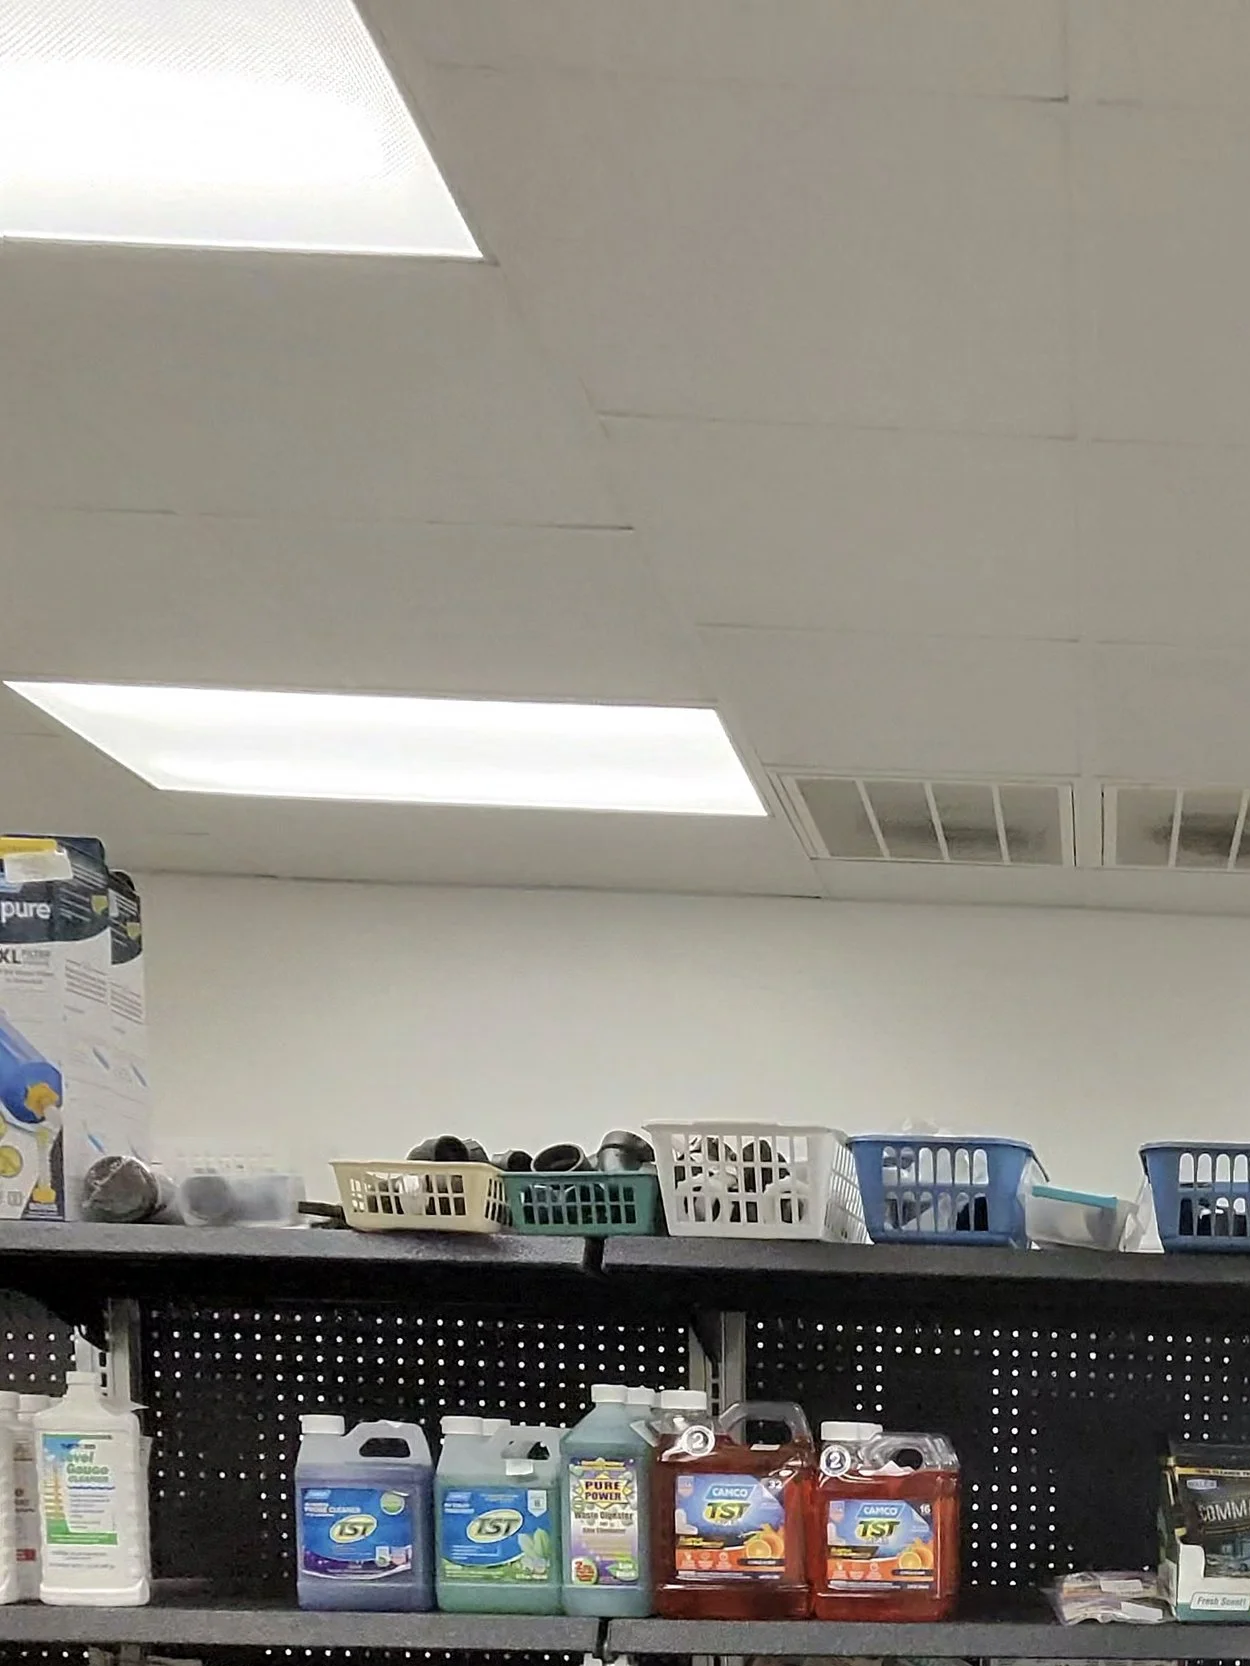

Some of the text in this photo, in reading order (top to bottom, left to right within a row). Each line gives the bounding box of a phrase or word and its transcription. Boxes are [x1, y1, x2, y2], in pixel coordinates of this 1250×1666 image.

[1, 901, 51, 923] pure
[585, 1481, 621, 1490] PURE
[768, 1480, 783, 1489] 32
[585, 1491, 622, 1501] POWER
[711, 1487, 748, 1498] CAMCO
[706, 1502, 752, 1520] TST
[862, 1505, 899, 1516] CAMCO
[920, 1503, 932, 1514] 16
[858, 1520, 901, 1537] TST
[1196, 1596, 1219, 1606] Fresh
